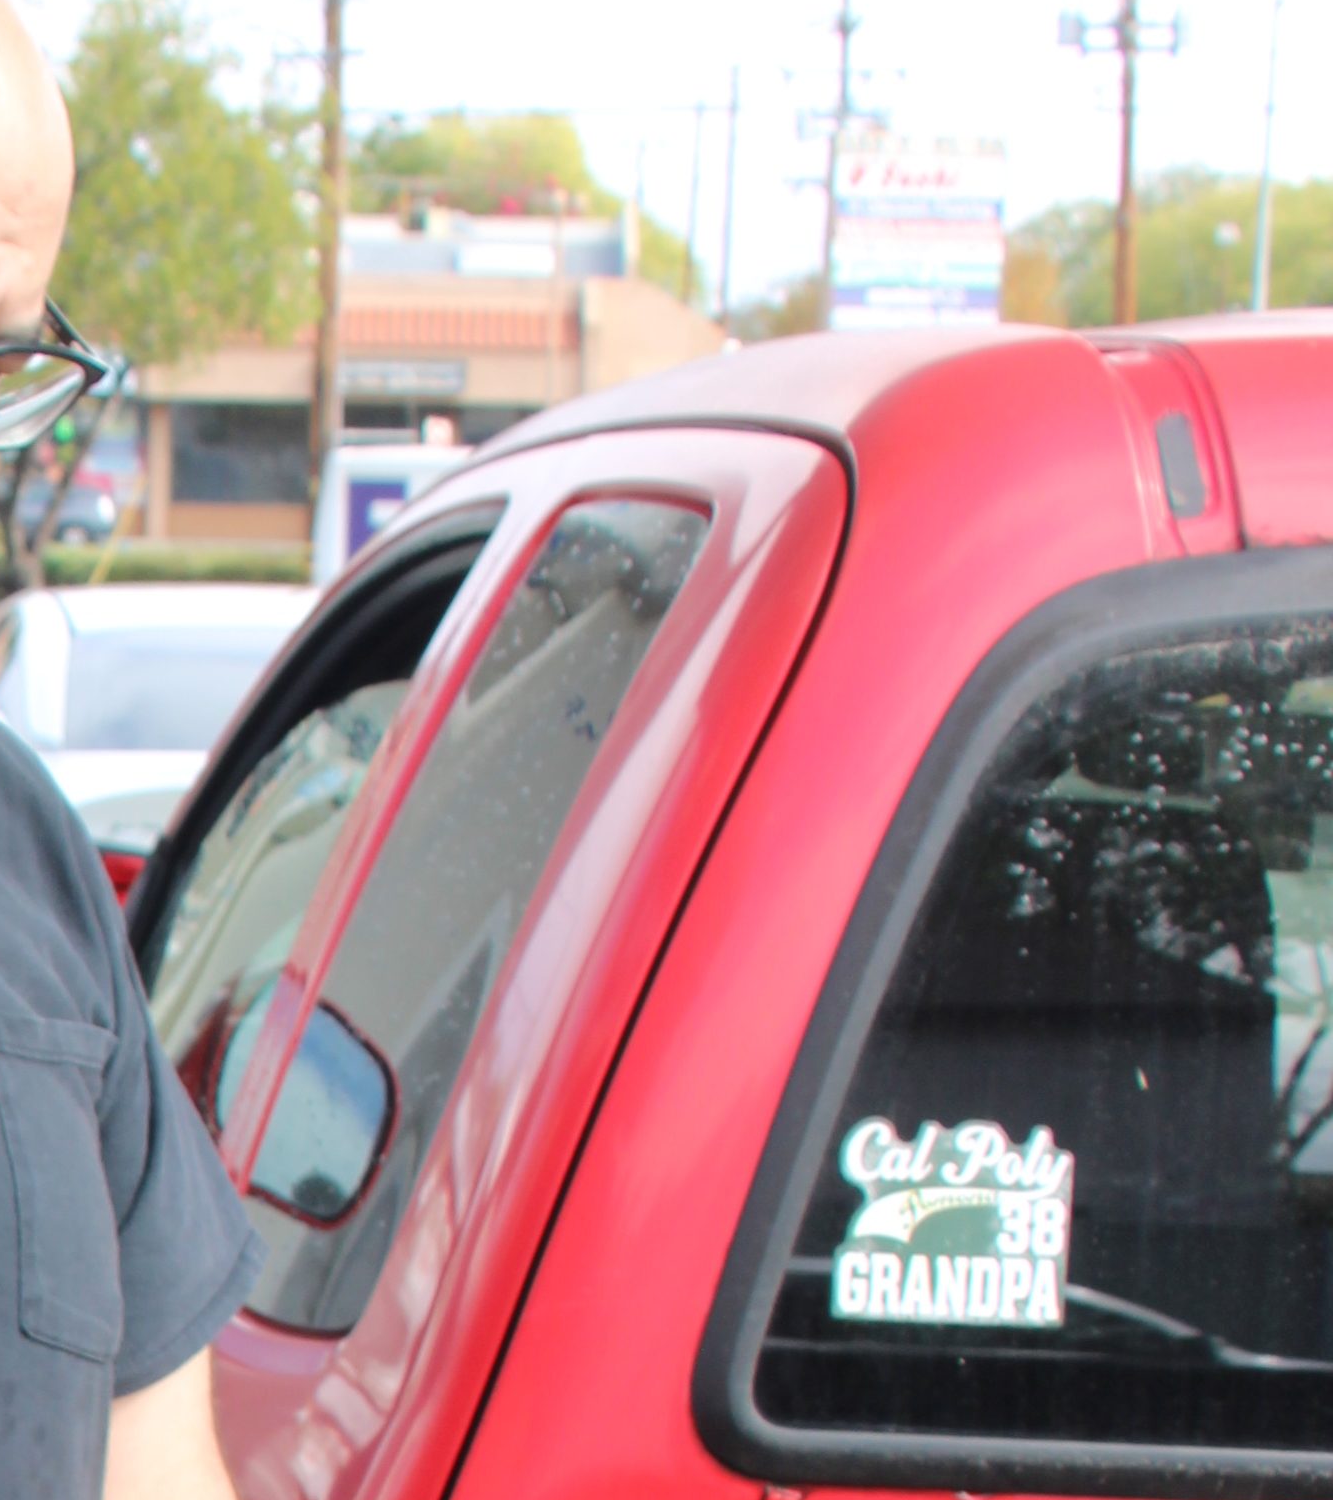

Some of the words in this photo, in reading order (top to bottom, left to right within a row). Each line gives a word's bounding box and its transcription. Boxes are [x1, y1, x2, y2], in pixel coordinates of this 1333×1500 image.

[844, 1120, 939, 1183] Cal
[939, 1122, 1071, 1197] Poly
[996, 1197, 1067, 1257] 38
[837, 1251, 1062, 1322] GRANDPA
